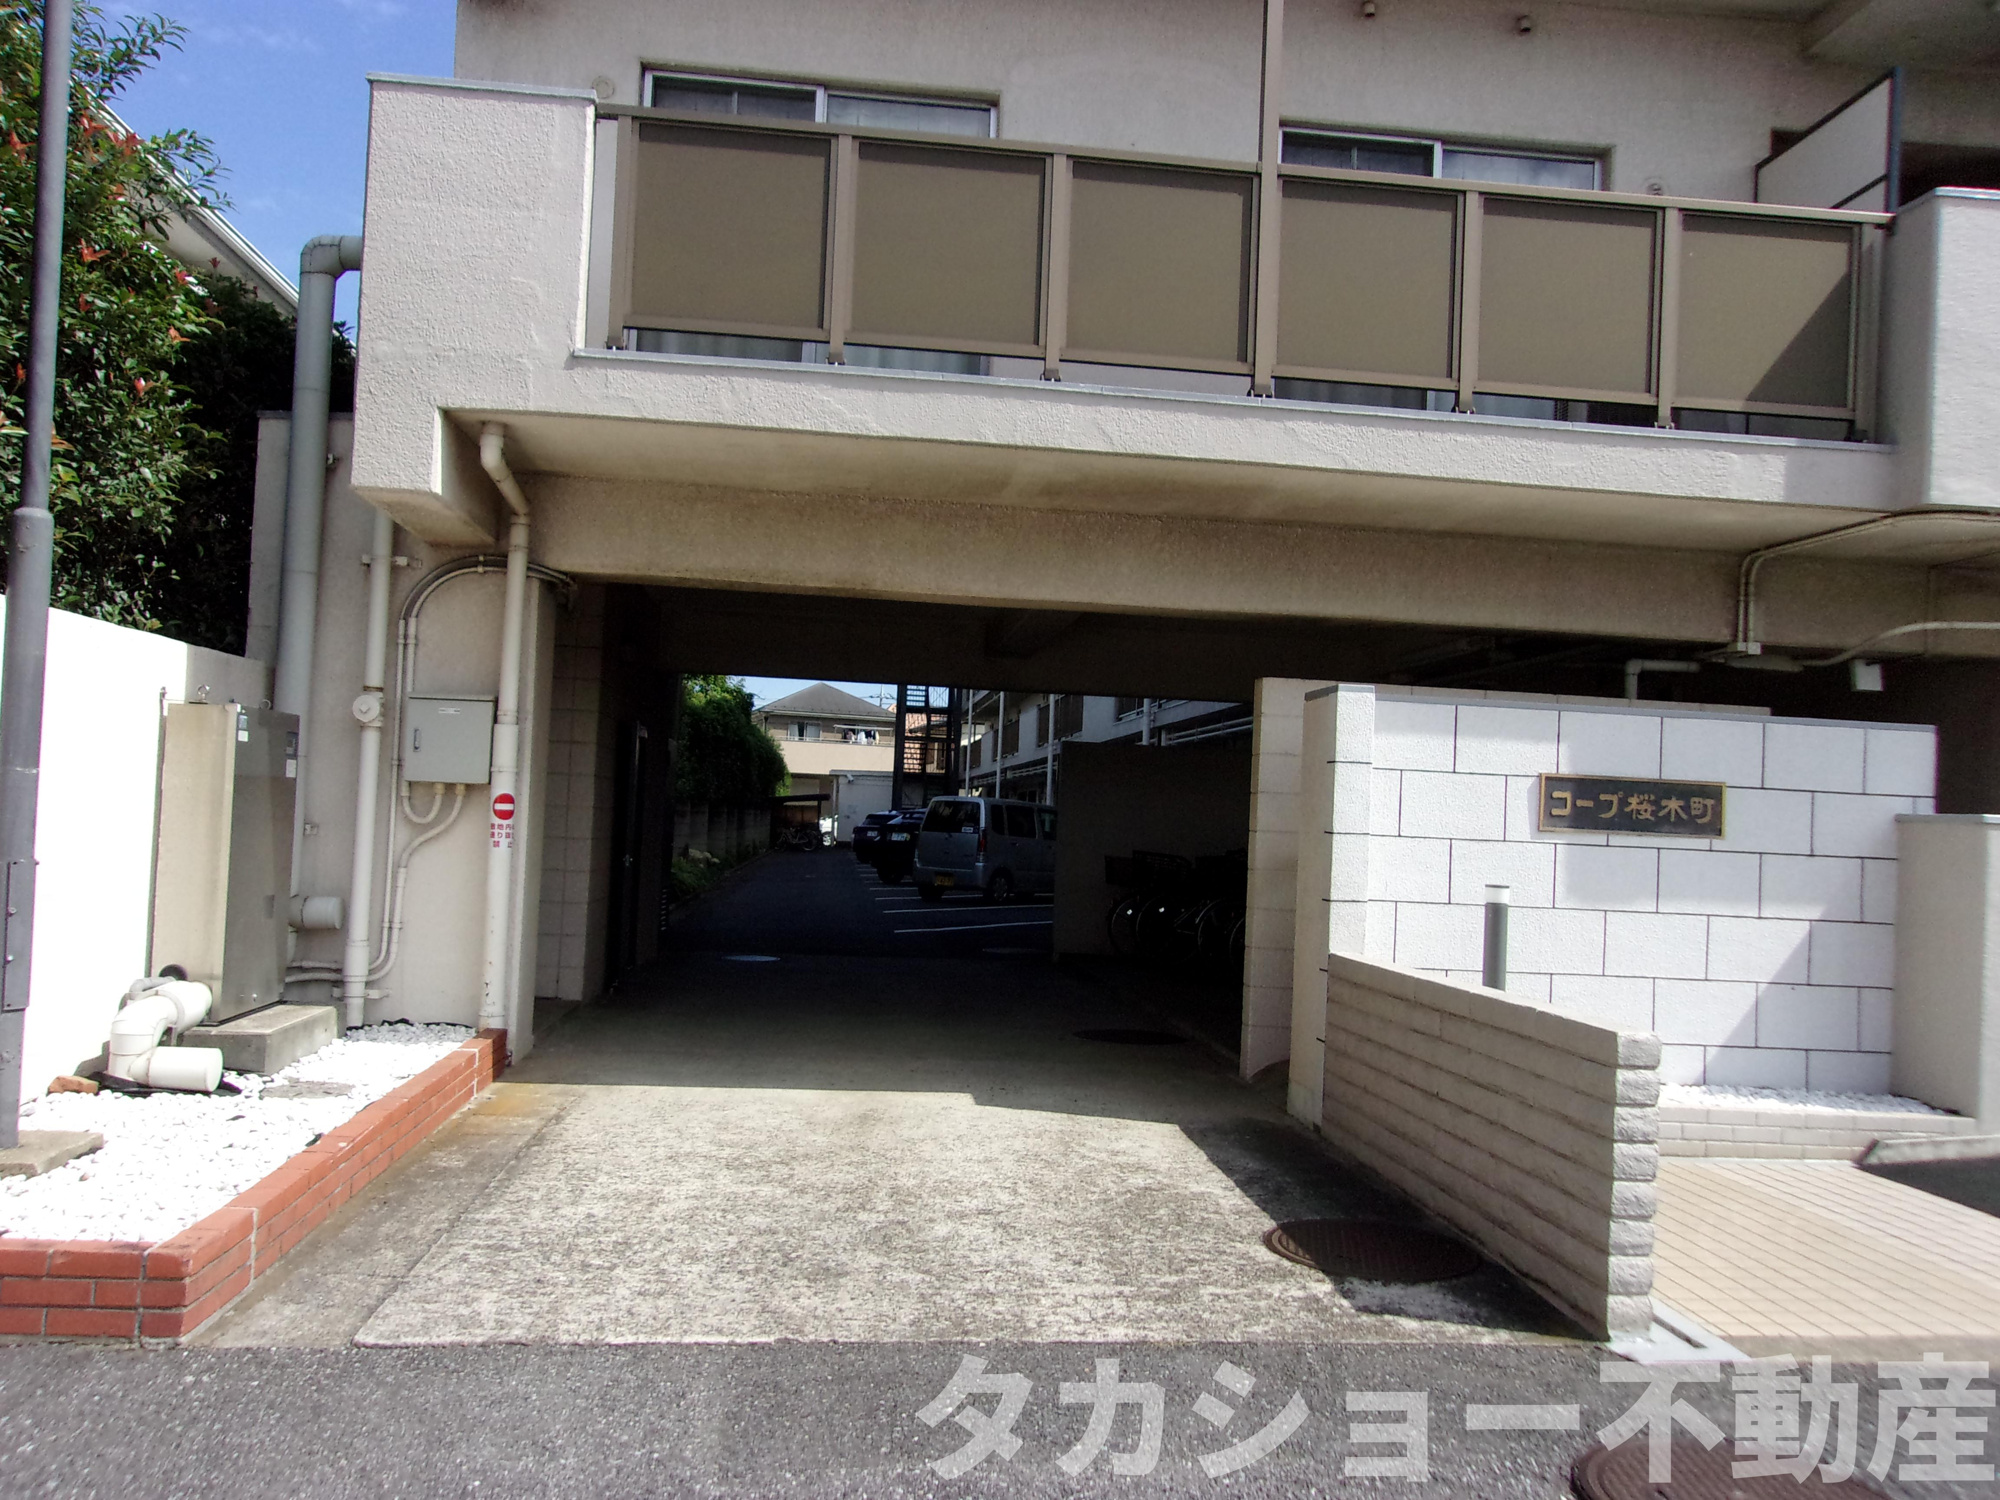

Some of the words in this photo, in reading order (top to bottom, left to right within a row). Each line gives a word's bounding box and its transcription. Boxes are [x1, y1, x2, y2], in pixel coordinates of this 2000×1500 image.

[1551, 791, 1715, 824] コープ桜木町
